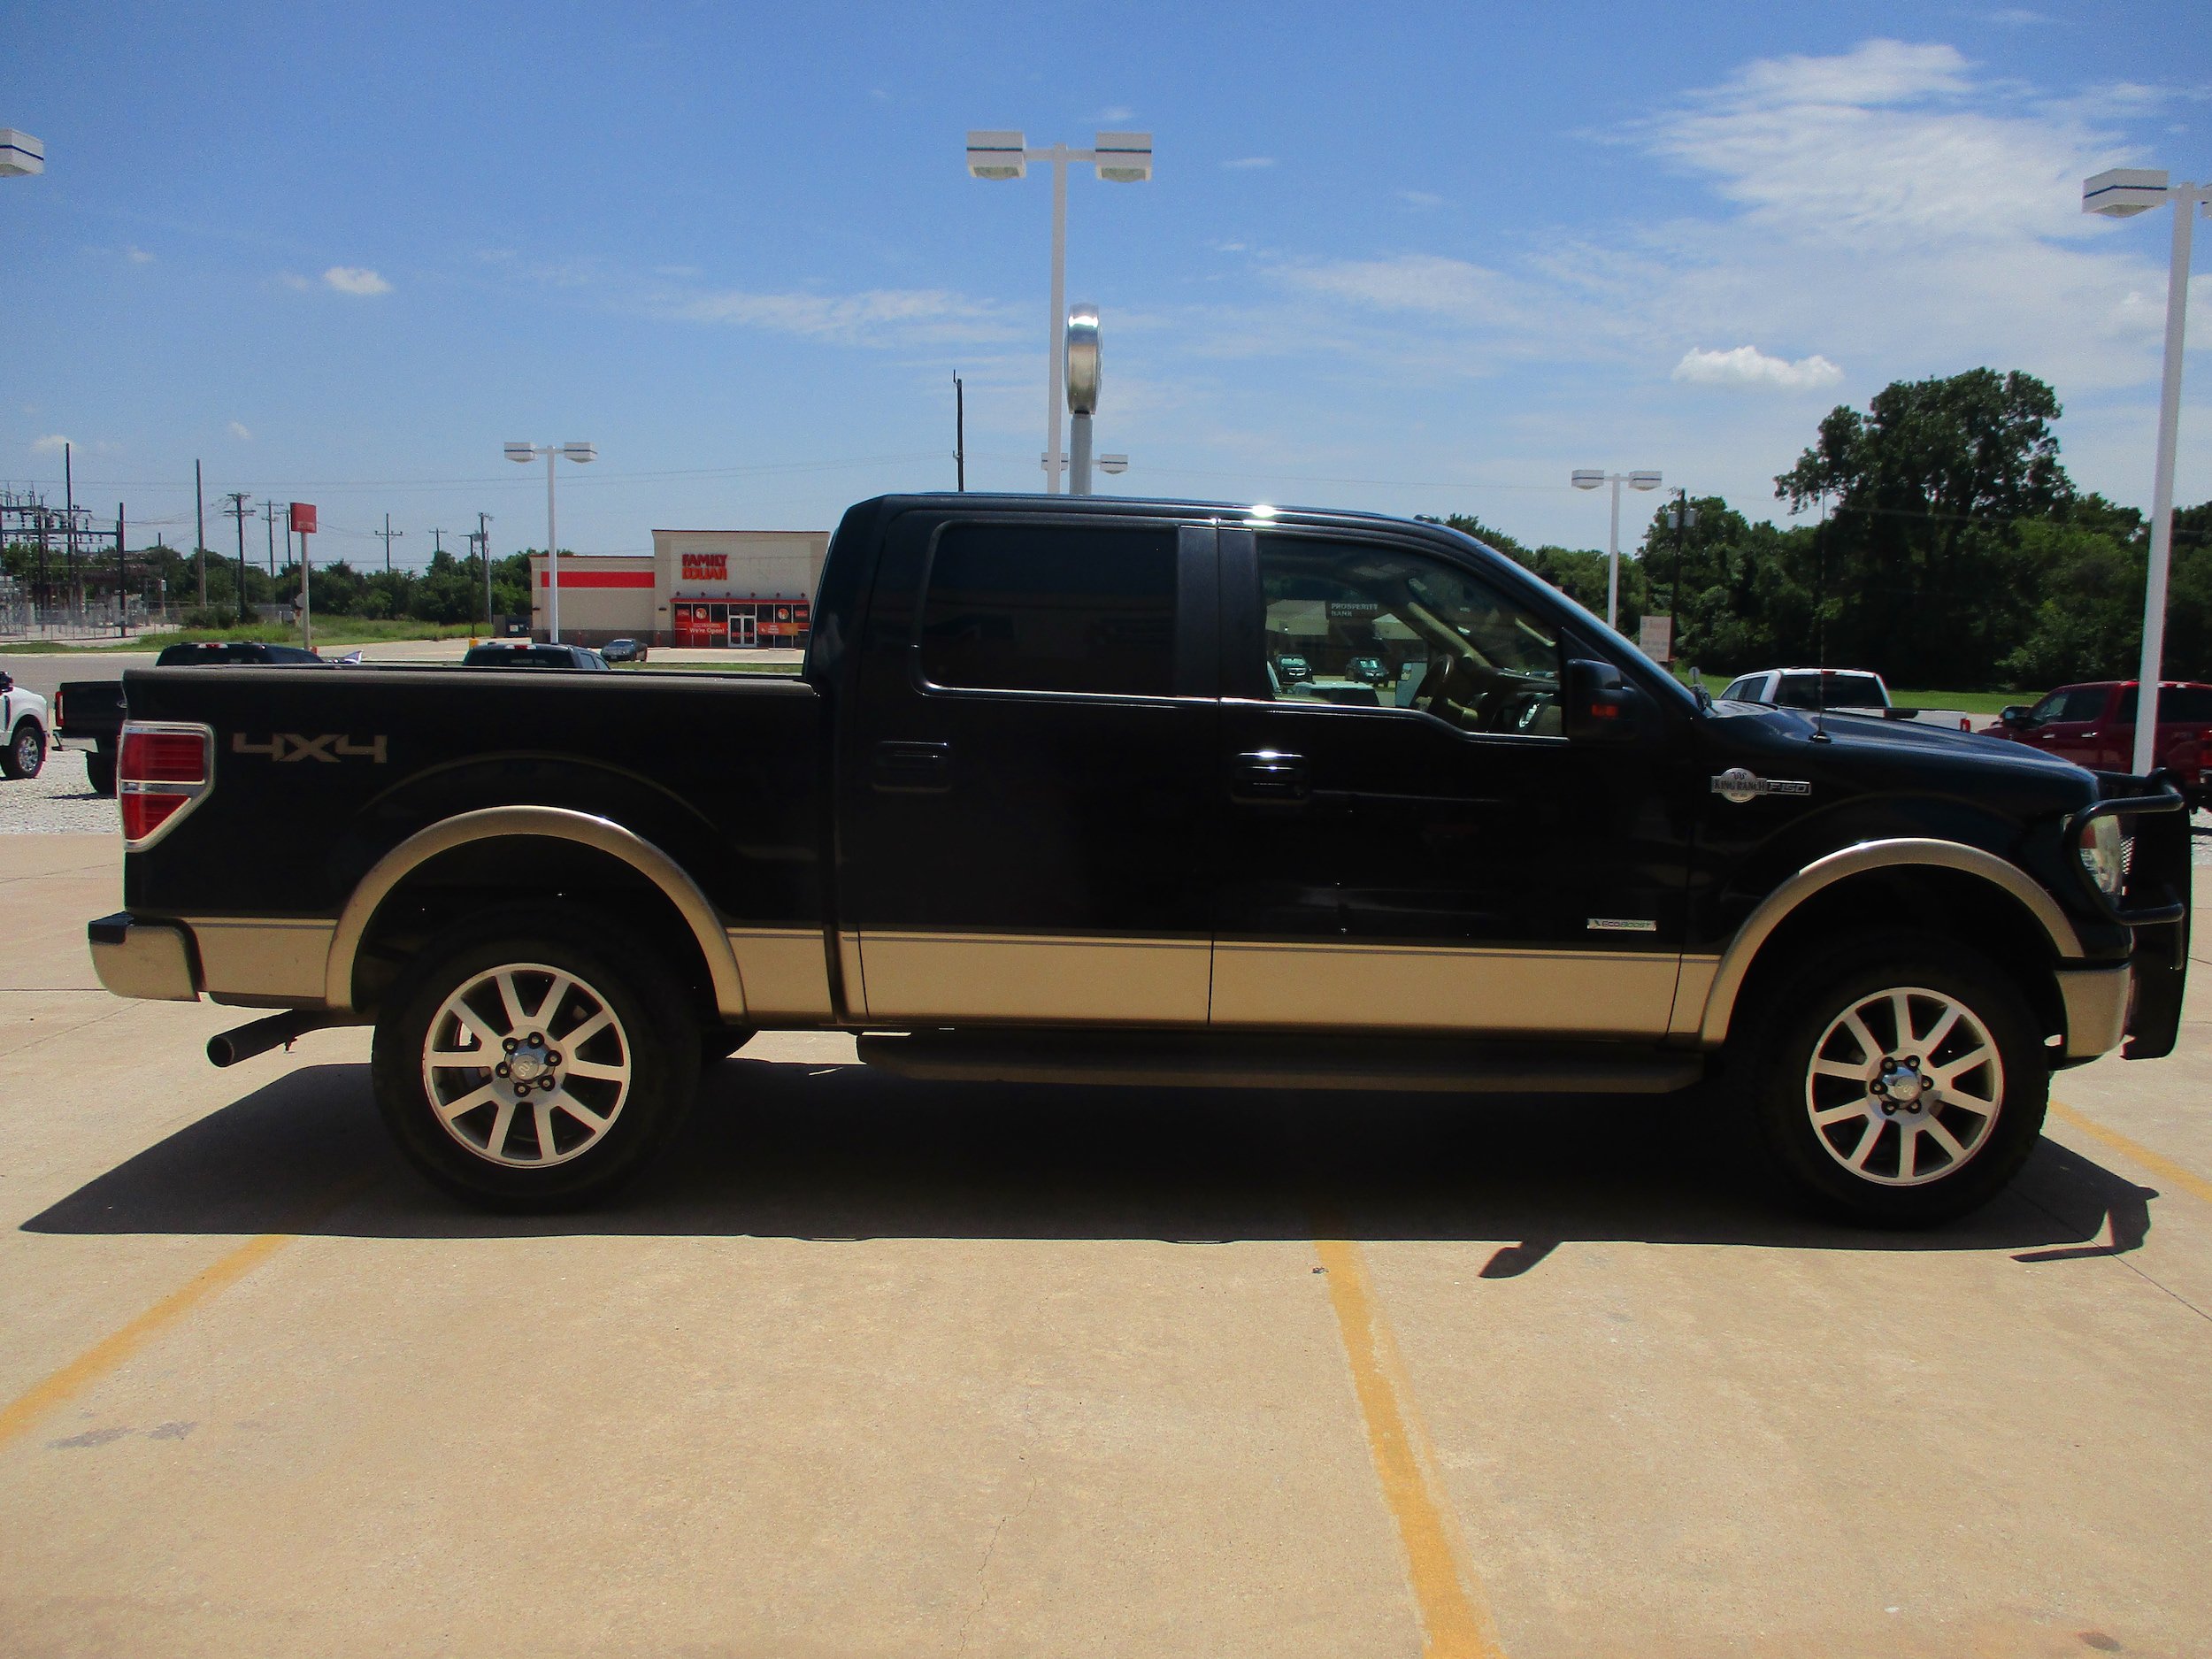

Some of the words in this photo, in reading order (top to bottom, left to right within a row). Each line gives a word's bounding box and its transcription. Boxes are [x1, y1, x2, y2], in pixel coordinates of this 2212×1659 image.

[682, 554, 727, 566] FAMILY
[682, 567, 727, 580] DOLLAR
[1714, 779, 1735, 790] KING
[1738, 779, 1765, 791] RANCH
